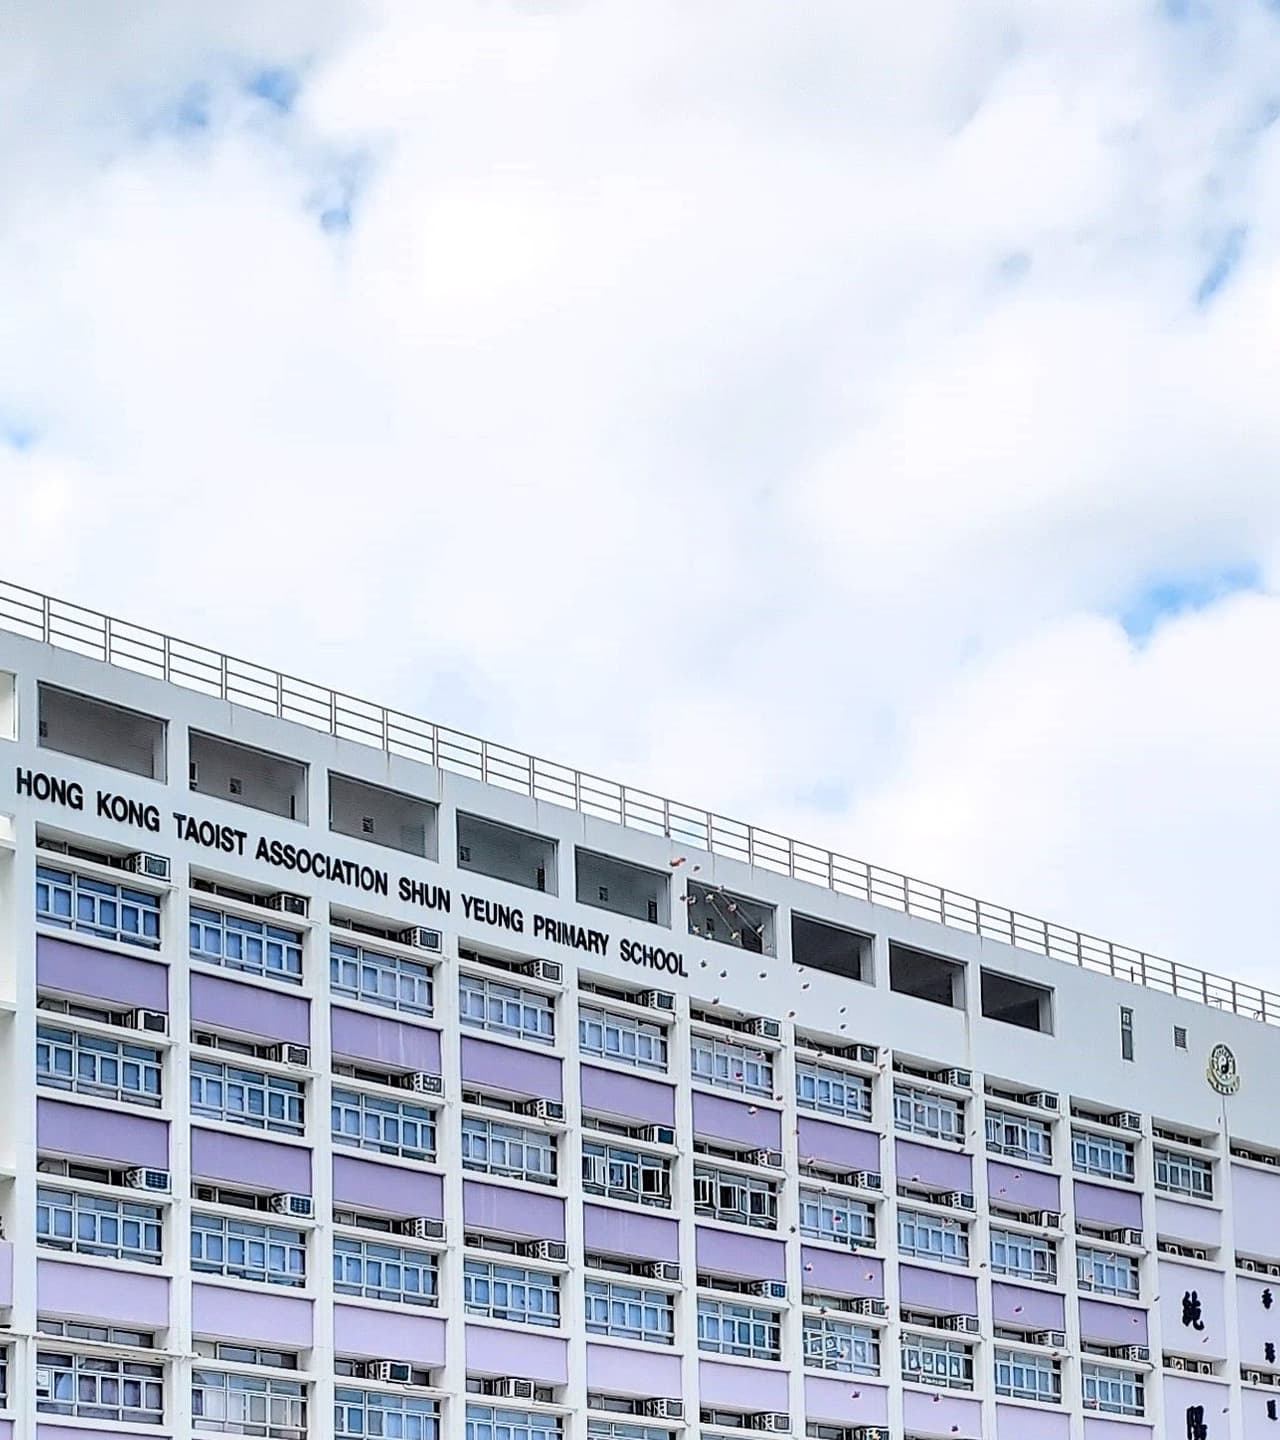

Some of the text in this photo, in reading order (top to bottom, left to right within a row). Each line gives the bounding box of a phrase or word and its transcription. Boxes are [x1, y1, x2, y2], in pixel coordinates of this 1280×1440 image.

[16, 767, 689, 978] HONG KONG TAOIST ASSOCIATION SHUN YEUNG PRIMARY SCHOOL
